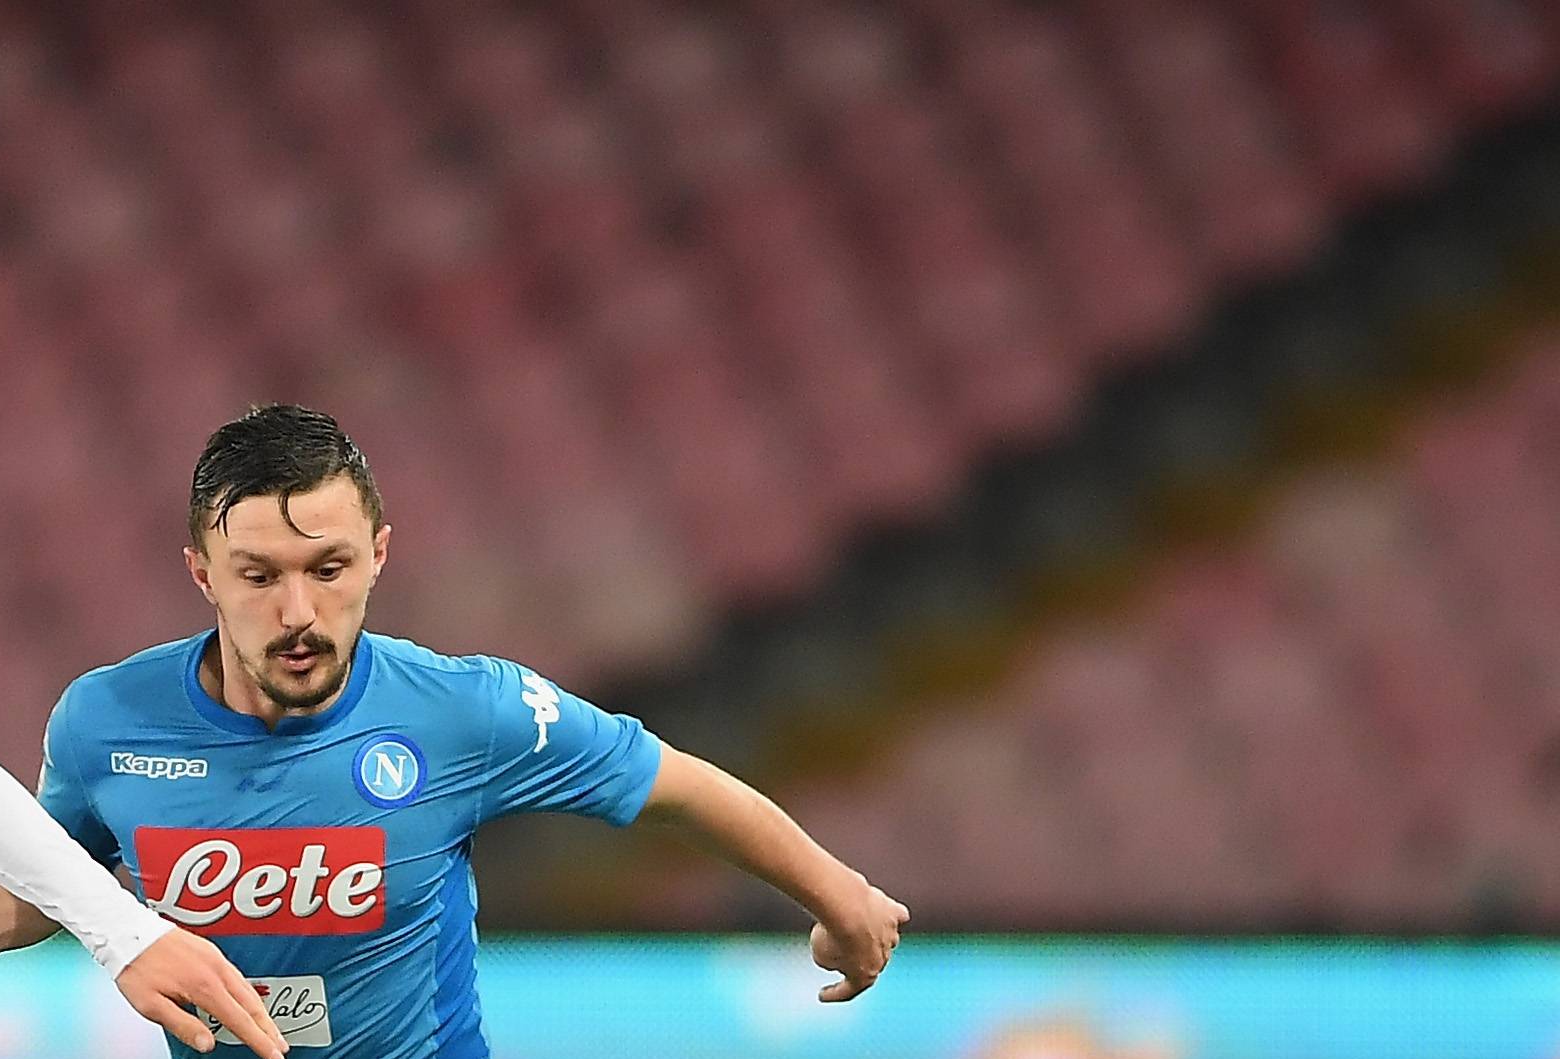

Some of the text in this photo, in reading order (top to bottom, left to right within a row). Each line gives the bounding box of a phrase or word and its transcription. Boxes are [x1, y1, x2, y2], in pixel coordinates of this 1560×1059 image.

[111, 752, 208, 779] Kappa
[372, 751, 408, 789] N
[146, 839, 383, 926] Lete
